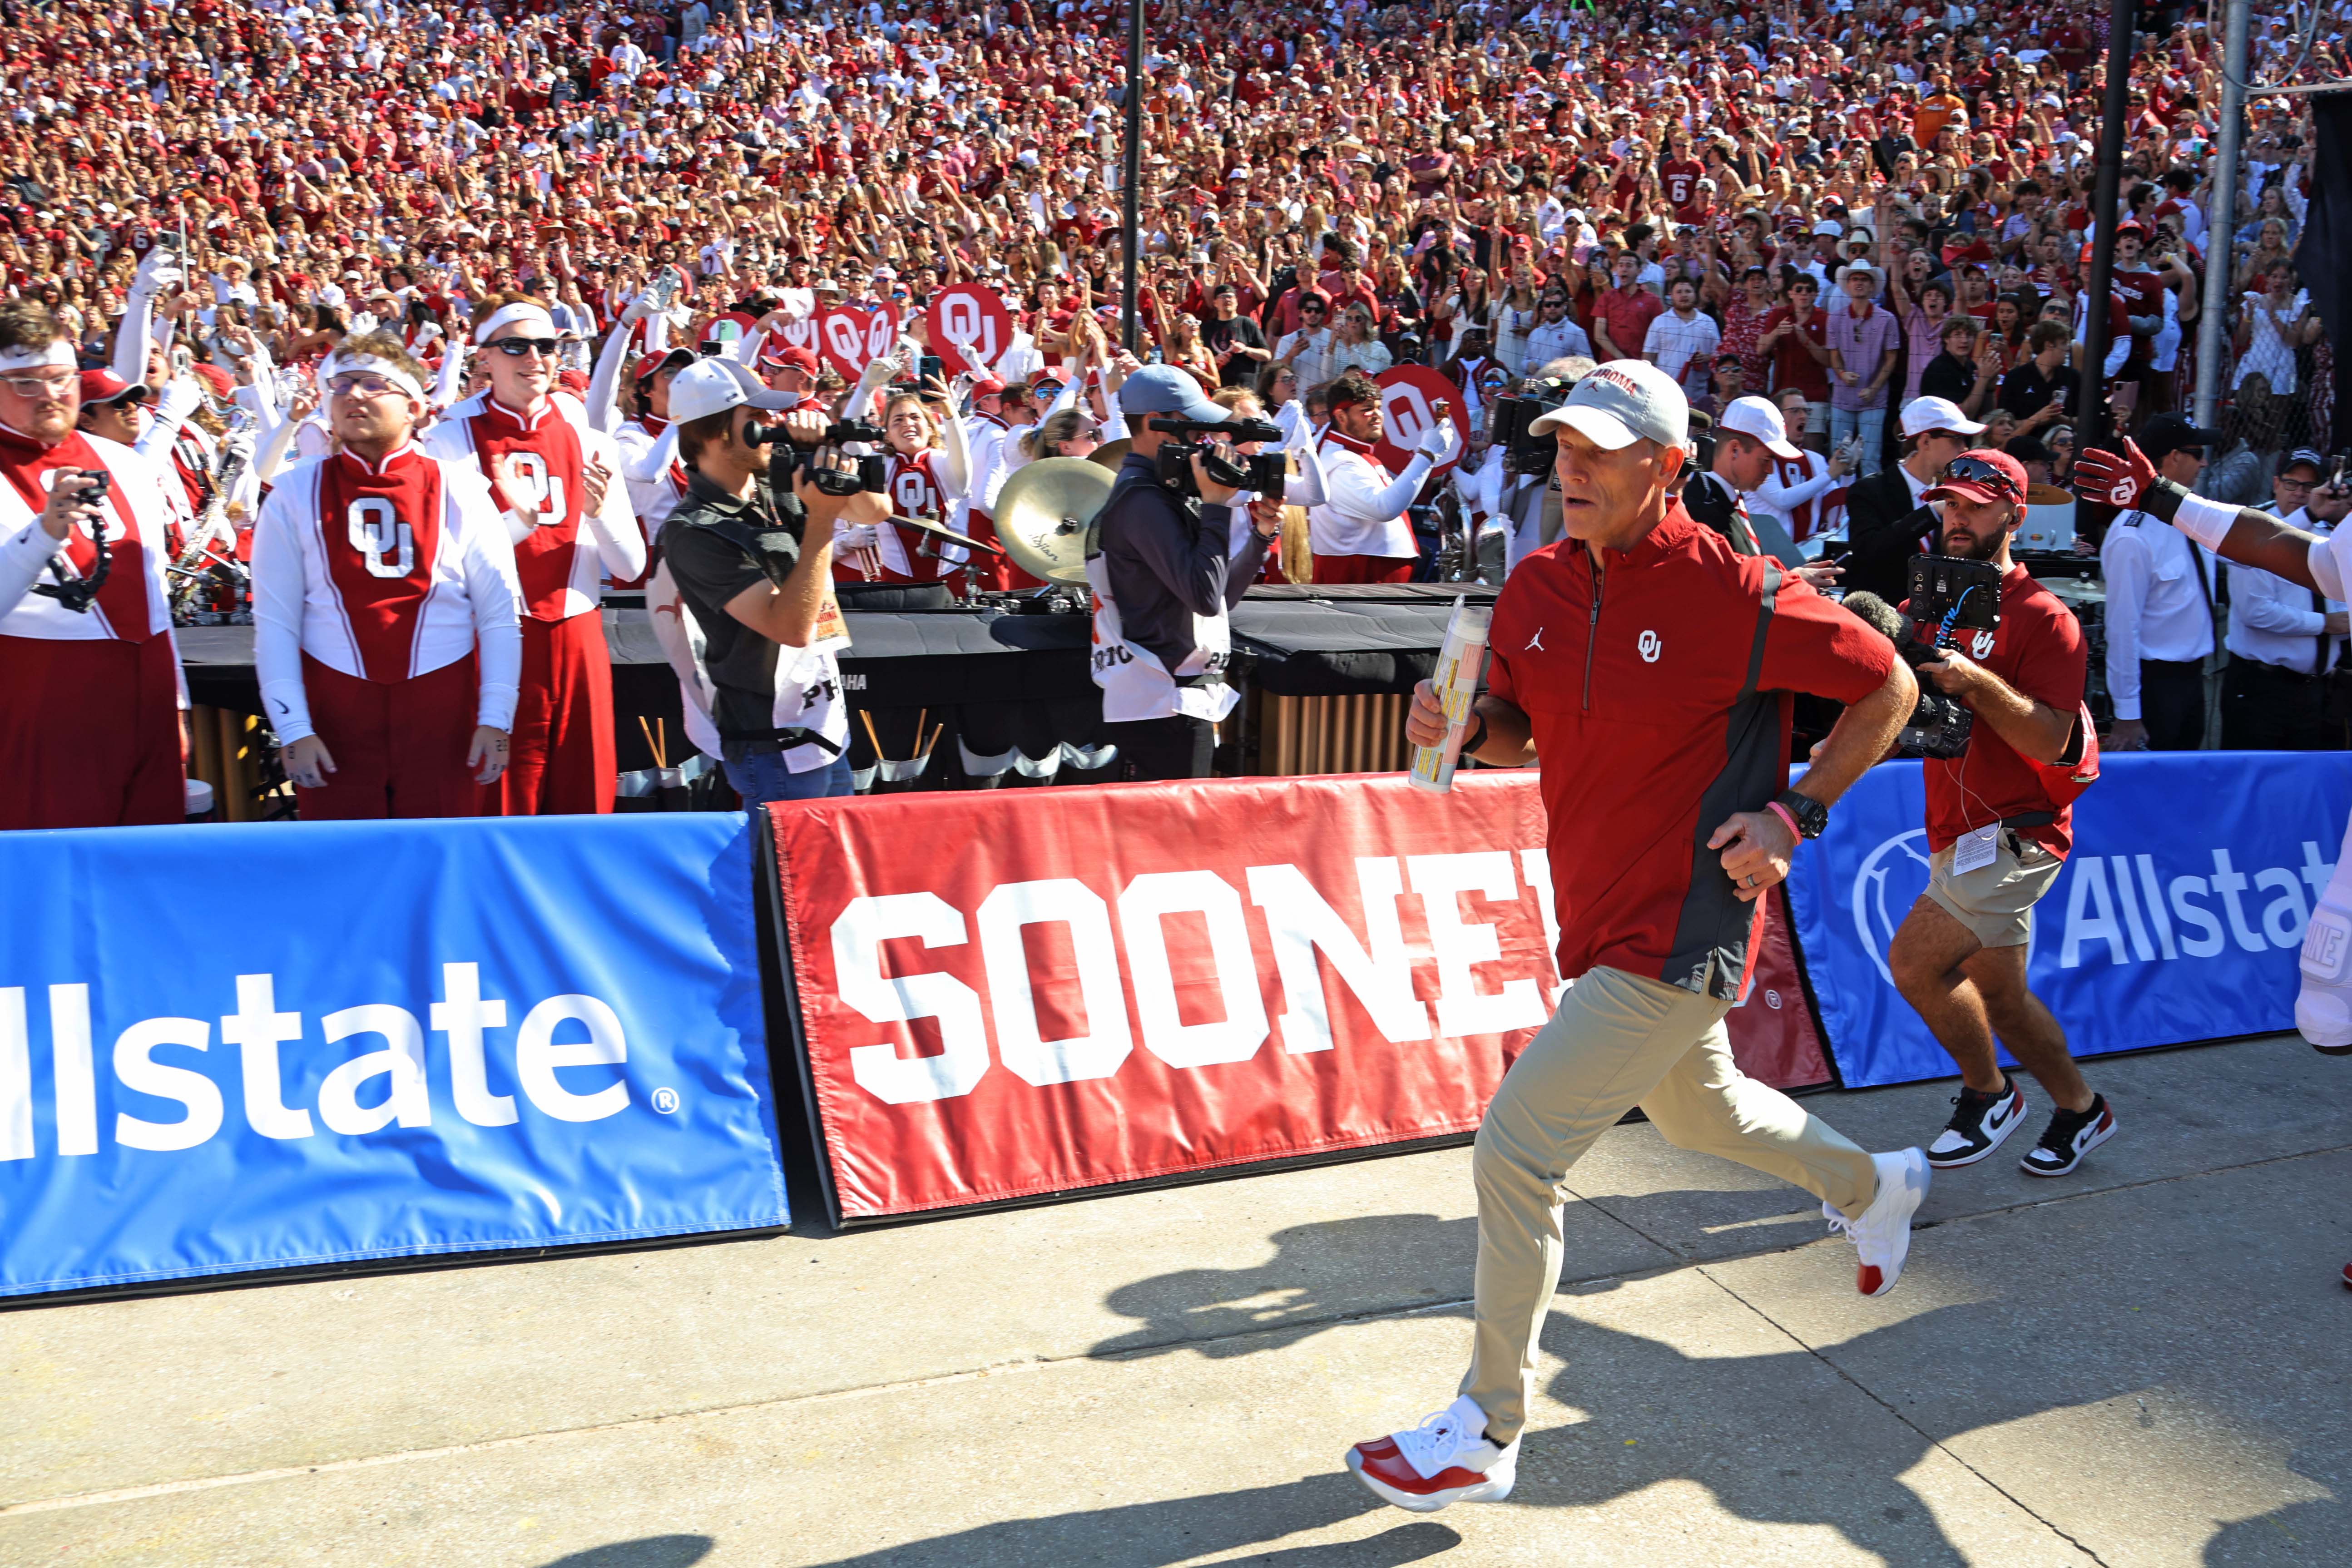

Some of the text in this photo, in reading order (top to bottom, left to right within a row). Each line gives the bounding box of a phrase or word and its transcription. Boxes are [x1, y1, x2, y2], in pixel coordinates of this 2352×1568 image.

[1672, 180, 1687, 202] 6
[134, 231, 149, 249] 6
[2109, 476, 2138, 506] OU
[347, 497, 414, 578] OU
[1638, 630, 1662, 663] OU
[1971, 630, 1996, 660] OU
[2060, 841, 2337, 968] Allstat
